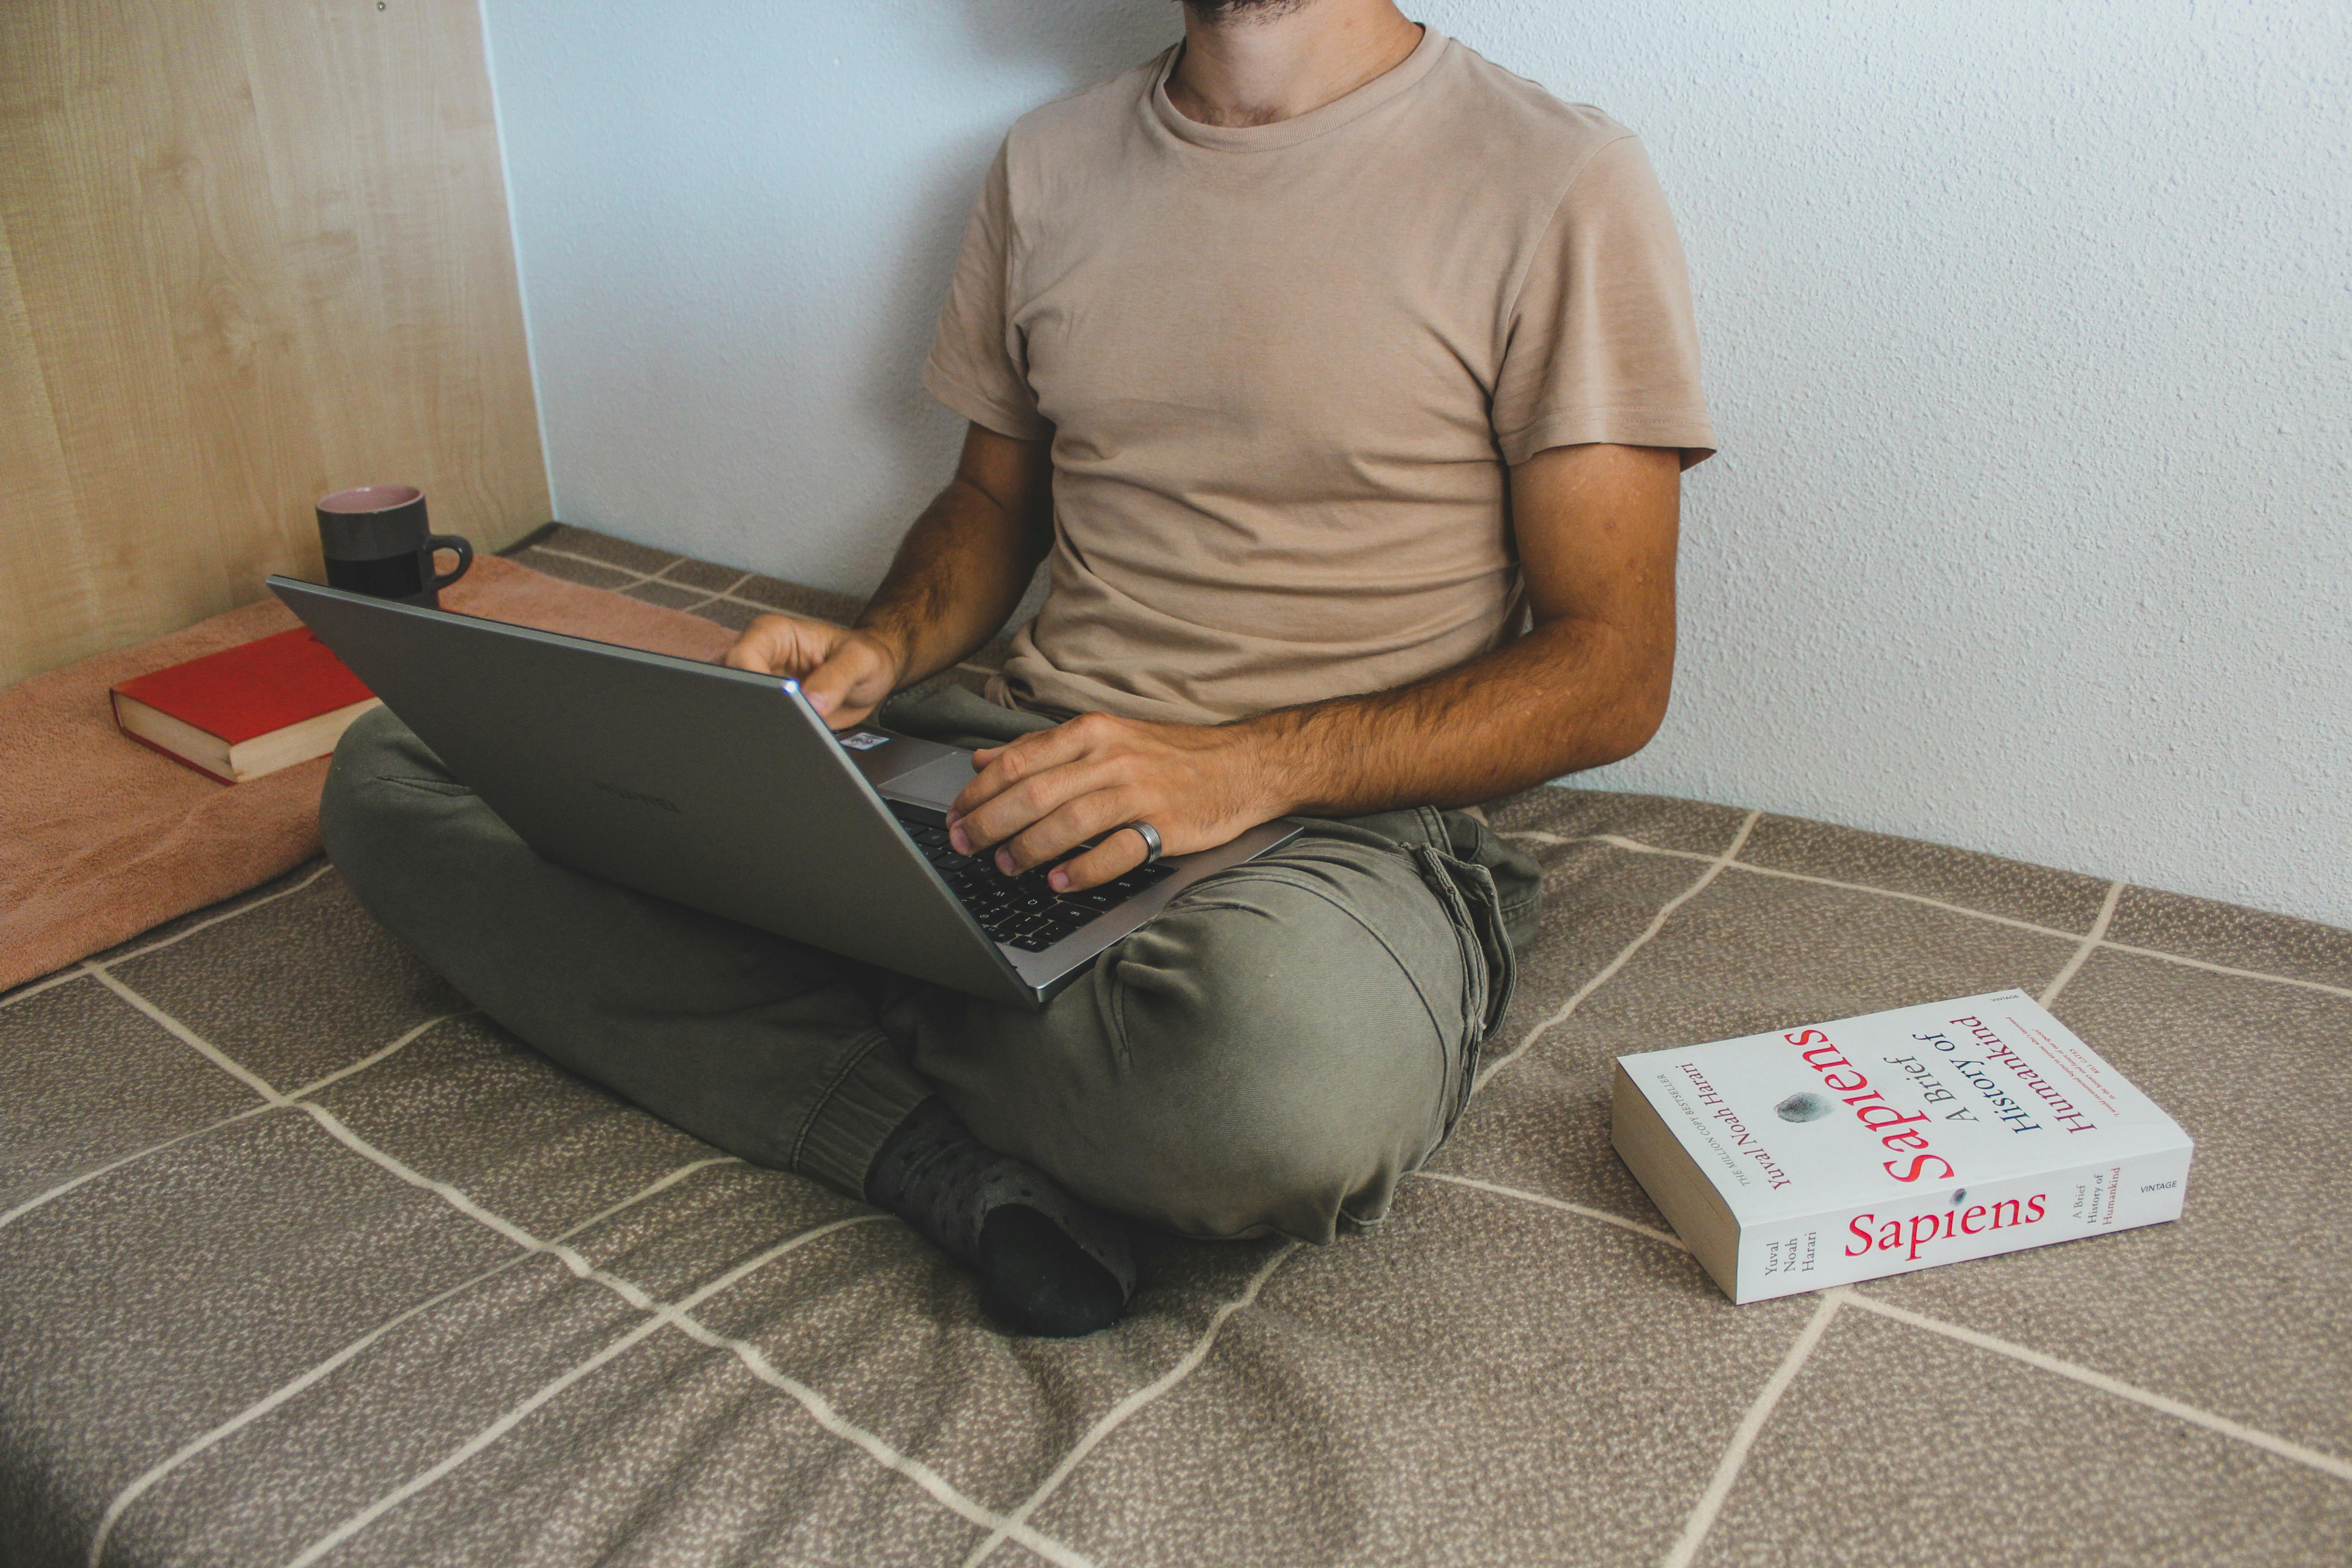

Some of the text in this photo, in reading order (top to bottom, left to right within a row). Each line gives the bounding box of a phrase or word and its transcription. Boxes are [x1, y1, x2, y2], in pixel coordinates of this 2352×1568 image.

[2005, 1017, 2029, 1034] interested
[2038, 1046, 2056, 1059] anyone
[2063, 1054, 2078, 1067] future
[2068, 1049, 2100, 1074] BILL GATES
[1912, 1032, 2043, 1134] History of
[1949, 1015, 2097, 1134] Humankind
[2058, 1063, 2076, 1078] Sapiens
[2085, 1074, 2102, 1088] history
[1784, 1029, 1955, 1183] Sapiens
[1883, 1056, 1980, 1122] A Brief
[2072, 1077, 2102, 1100] recommend
[2098, 1100, 2116, 1113] would
[1656, 1074, 1751, 1187] THE MILLION COPY BESTSELLER
[1675, 1063, 1792, 1191] Yuval Noah Harari
[2072, 1185, 2086, 1219] A Brief
[2087, 1174, 2104, 1224] History of
[2102, 1167, 2121, 1225] Humankind
[2141, 1181, 2177, 1193] VINTAGE
[1845, 1194, 2046, 1261] Sapiens
[1765, 1241, 1779, 1276] Yuval
[1784, 1237, 1798, 1273] Noah
[1802, 1231, 1817, 1273] Harari
